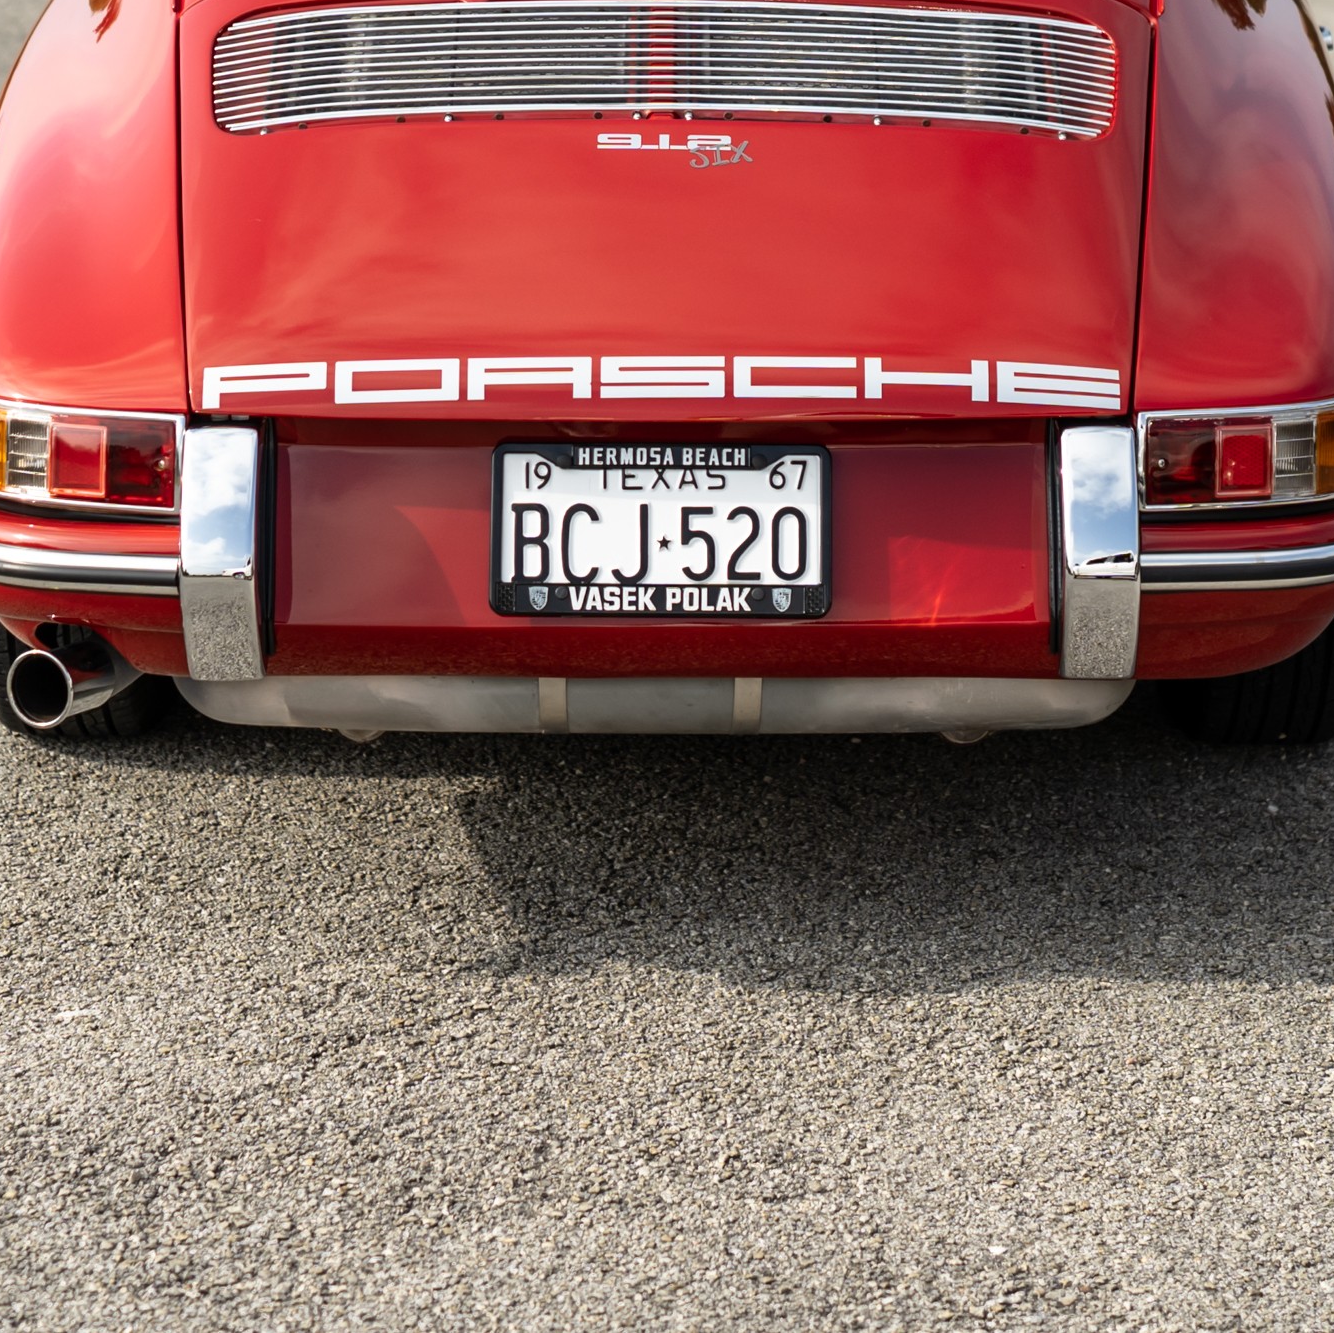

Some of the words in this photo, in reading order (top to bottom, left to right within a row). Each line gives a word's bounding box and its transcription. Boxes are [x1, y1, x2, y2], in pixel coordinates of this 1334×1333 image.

[689, 140, 753, 169] SIX
[203, 356, 1121, 410] PORSCHE
[578, 447, 674, 466] HERMOSA
[682, 447, 746, 466] BEACH
[524, 461, 551, 489] 19
[769, 460, 807, 490] 67
[569, 586, 657, 611] VASEK
[666, 587, 751, 612] POLAK
